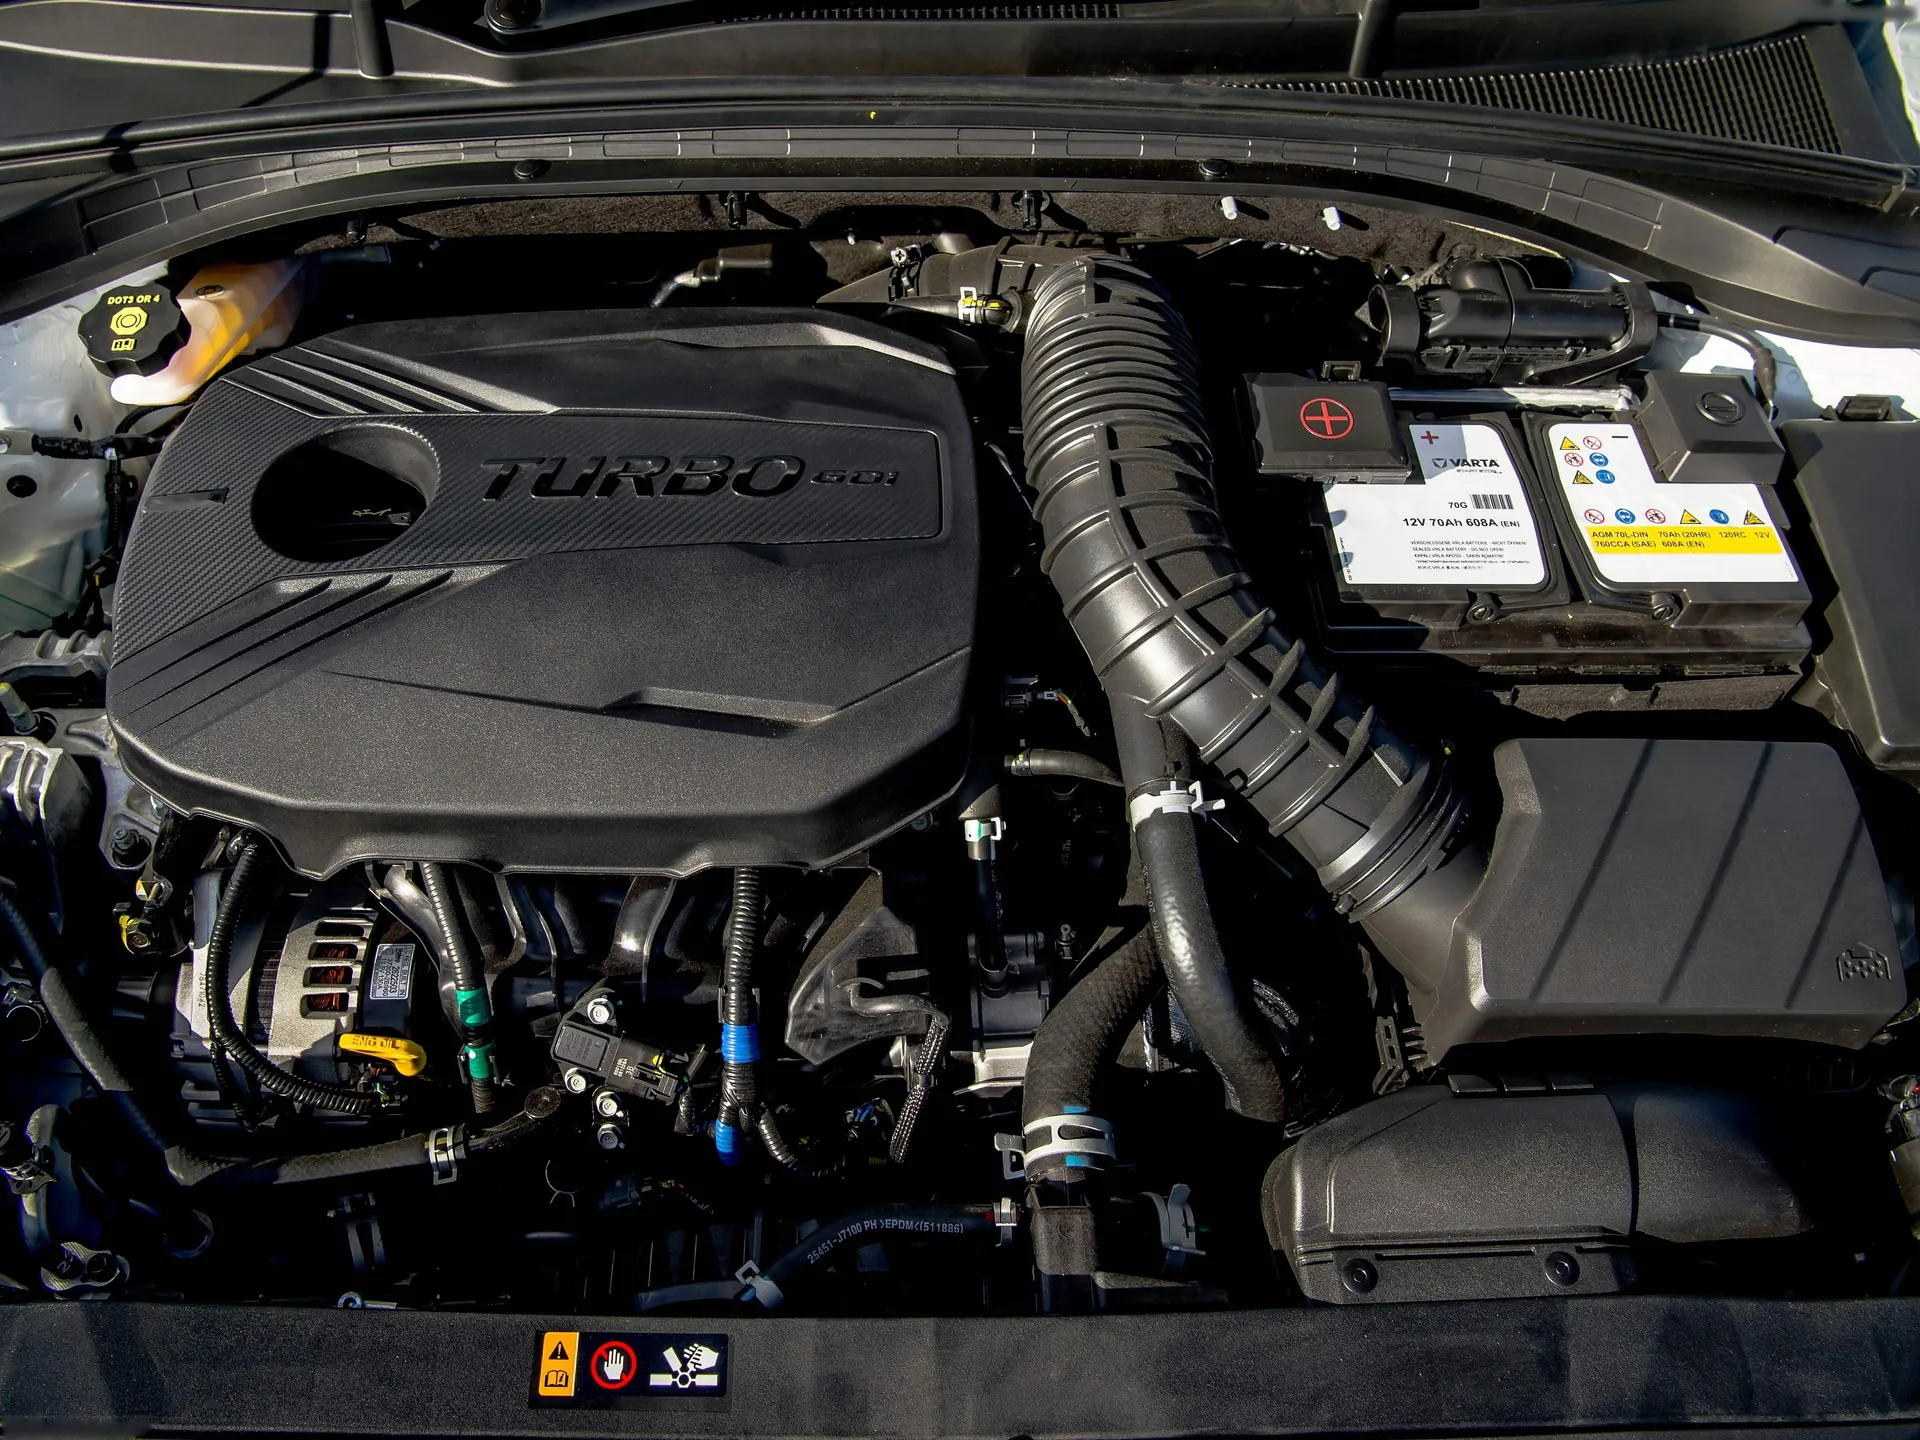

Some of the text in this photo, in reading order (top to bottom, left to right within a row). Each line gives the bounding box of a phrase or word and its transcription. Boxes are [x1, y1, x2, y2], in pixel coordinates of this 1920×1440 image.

[107, 294, 161, 305] DOT3 OR 4
[1449, 458, 1500, 468] VARTA
[480, 454, 806, 501] TURBO
[1448, 501, 1468, 509] 70G
[1402, 517, 1520, 528] 12V 70Ah 608A (EN)
[1682, 531, 1711, 539] (20HR)
[1594, 540, 1705, 548] 760CCA (SAE) 608A (EN)
[352, 1035, 401, 1050] ENG OIL
[806, 1222, 863, 1265] 25451-J7100
[863, 1219, 878, 1231] PH
